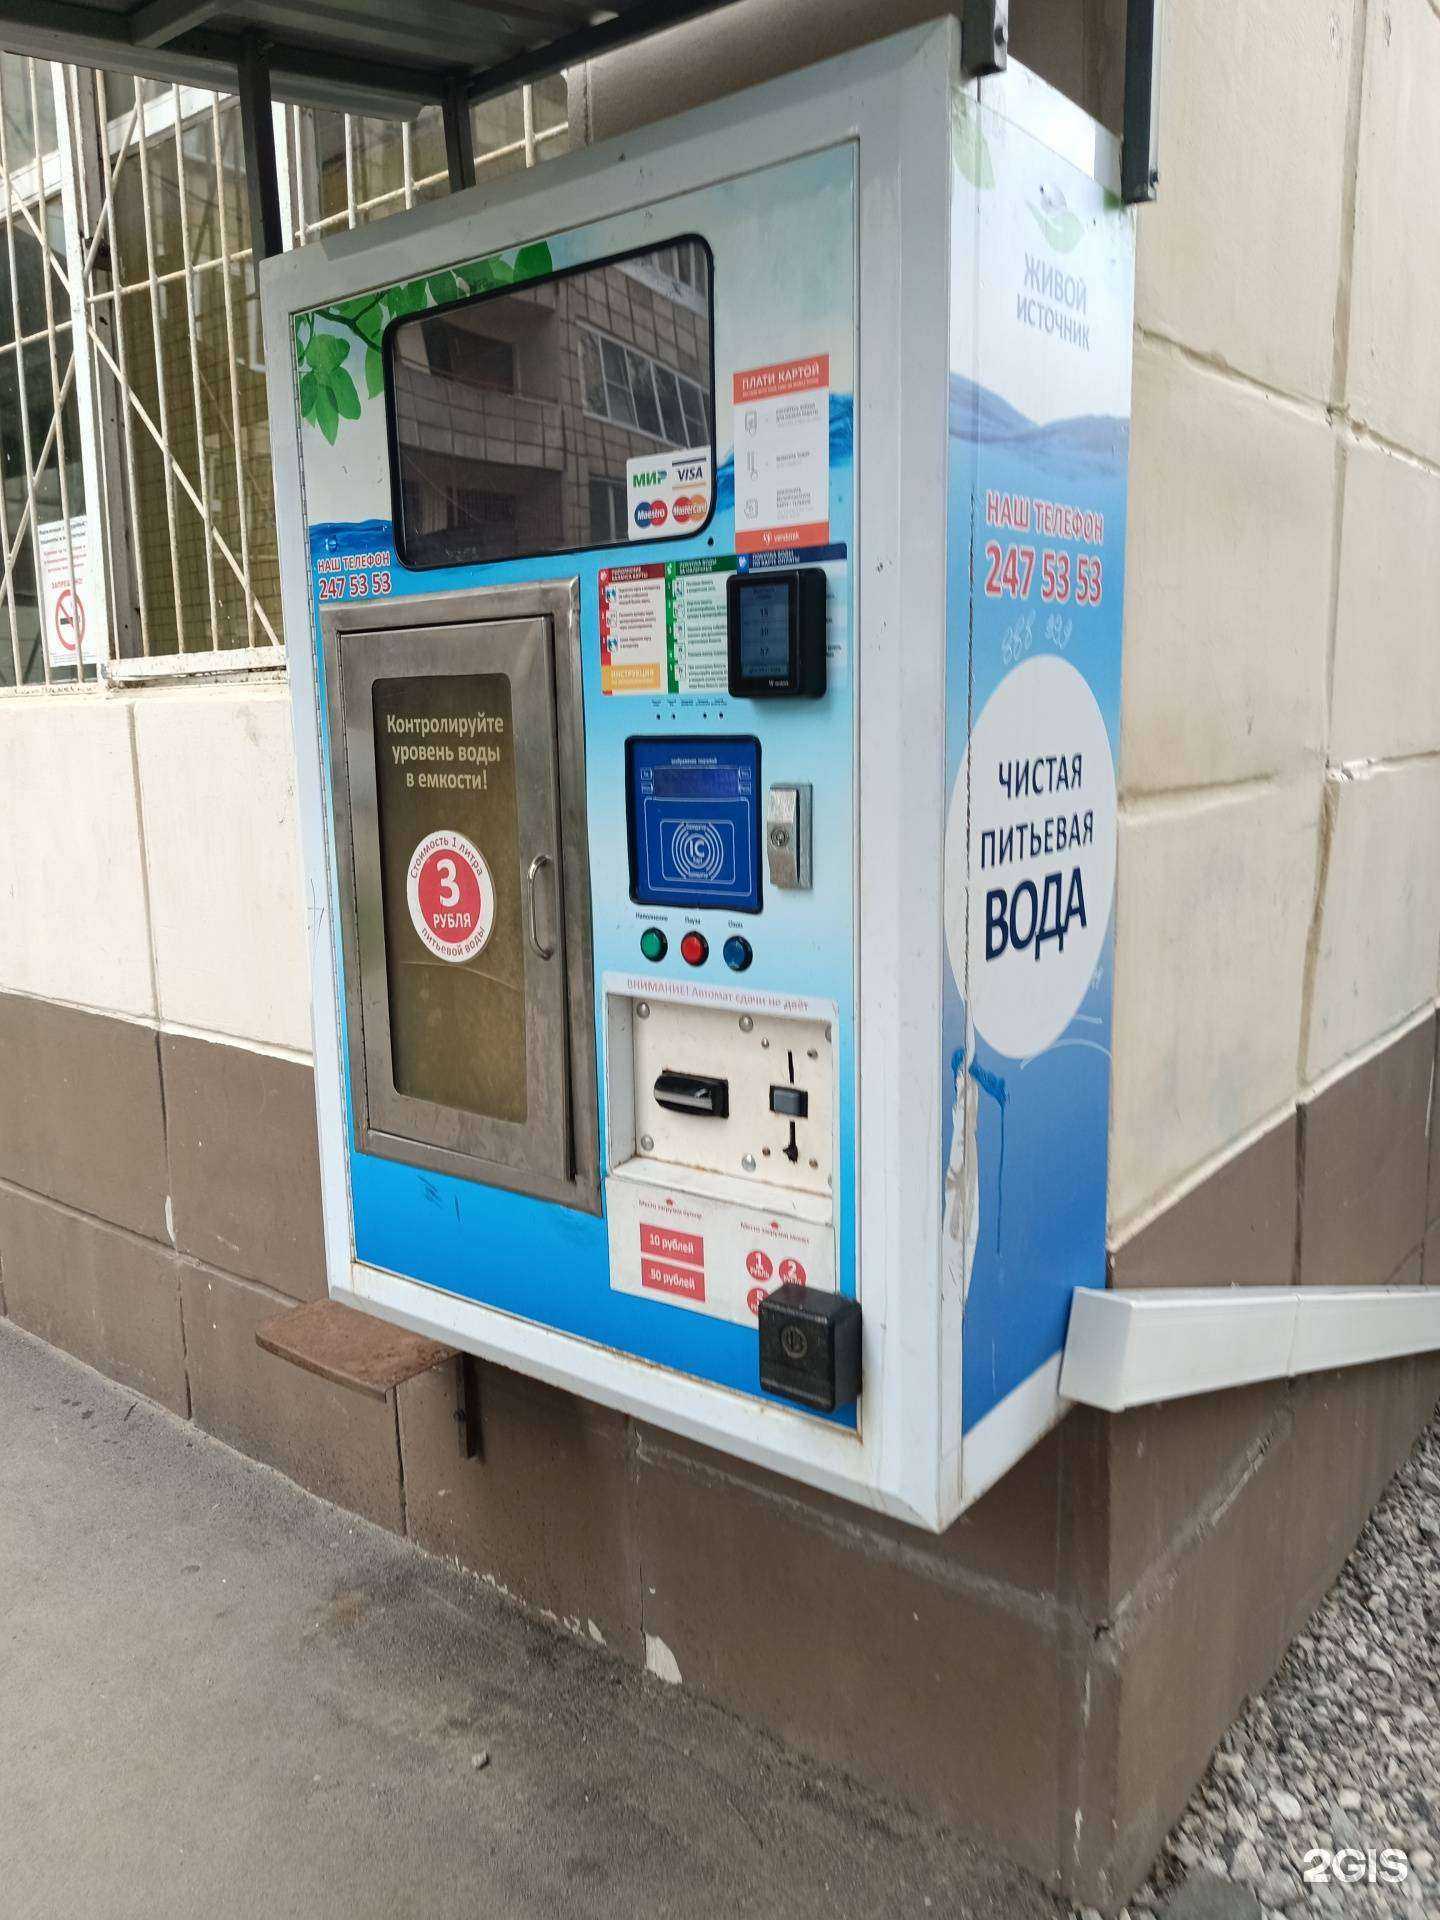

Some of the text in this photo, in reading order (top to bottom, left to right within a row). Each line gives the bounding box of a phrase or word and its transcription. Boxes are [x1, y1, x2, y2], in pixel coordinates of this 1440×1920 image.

[1025, 251, 1086, 315] ЖИВОЙ
[1017, 293, 1089, 352] ИСТОЧНИК
[743, 373, 775, 390] ПЛАТИ
[779, 362, 819, 382] КАРТОЙ
[633, 470, 667, 487] МИР
[678, 466, 703, 481] VISA
[638, 508, 665, 521] Maestro
[987, 490, 1104, 545] НАШ ТЕЛЕФОН
[318, 551, 390, 573] НАШ ТЕЛЕФОН
[985, 540, 1103, 606] 247 53 53
[319, 571, 391, 599] 247 53 53
[386, 712, 504, 738] Контролируйте
[392, 745, 501, 765] уровень воды
[406, 769, 488, 790] в емкости!
[998, 754, 1082, 799] ЧИСТАЯ
[981, 809, 1094, 871] ПИТЬЕВАЯ
[459, 844, 483, 876] литра
[436, 858, 460, 907] 3
[433, 912, 471, 929] РУБЛЯ
[985, 866, 1087, 962] ВОДА
[421, 927, 485, 957] питьевой воды
[627, 979, 689, 997] ВНИМАНИЕ!
[691, 989, 734, 1002] Автомат
[735, 995, 767, 1008] сдачи
[769, 998, 781, 1008] не
[649, 1233, 694, 1255] 10 рублей
[755, 1251, 762, 1267] 1
[787, 1261, 797, 1275] 2
[650, 1268, 695, 1291] 50 рублей
